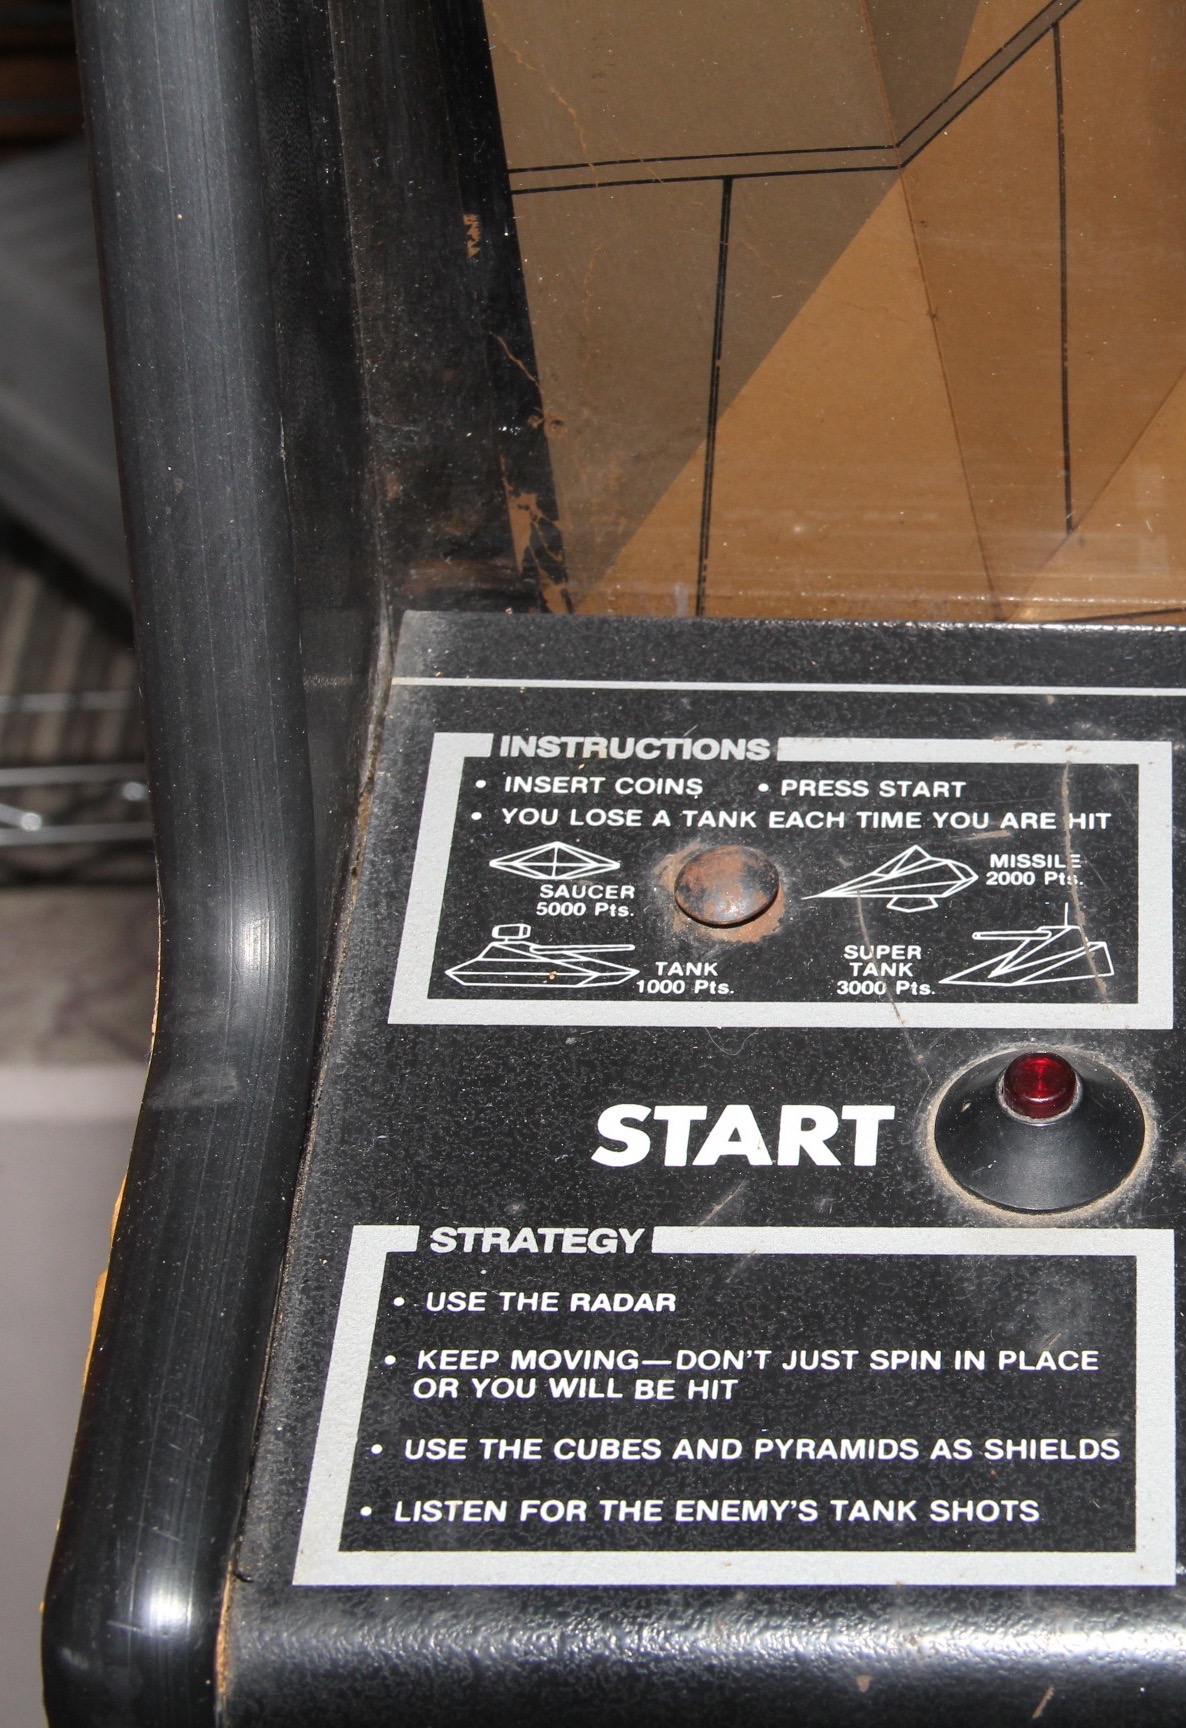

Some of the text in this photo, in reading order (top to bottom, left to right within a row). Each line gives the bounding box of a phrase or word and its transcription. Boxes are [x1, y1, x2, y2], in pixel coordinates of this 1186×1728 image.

[499, 735, 771, 761] INSTRUCTIONS
[504, 775, 704, 797] INSERT COINS
[780, 778, 967, 798] PRESS START
[501, 807, 1112, 830] YOU LOSE A TANK EACH TIME YOU ARE HIT
[989, 852, 1082, 870] MISSILE
[985, 870, 1085, 887] 2000 Pts.
[539, 883, 636, 900] SAUCER
[535, 901, 635, 918] 5000 Pts.
[843, 944, 922, 961] SUPER
[654, 961, 719, 977] TANK
[849, 961, 914, 978] TANK
[636, 979, 735, 995] 1000 Pts.
[836, 979, 936, 996] 3000 Pts.
[590, 1103, 896, 1167] START
[429, 1226, 646, 1254] STRATEGY
[426, 1291, 677, 1312] USE THE RADAR
[417, 1349, 500, 1371] KEEP
[781, 1349, 860, 1371] JUST
[869, 1349, 942, 1371] SPIN
[954, 1350, 985, 1371] IN
[998, 1350, 1099, 1371] PLACE
[412, 1377, 739, 1400] OR YOU WILL BE HIT
[404, 1438, 1121, 1461] USE THE CUBES AND PYRAMIDS AS SHIELDS
[394, 1499, 1040, 1523] LISTEN FOR THE ENEMY'S TANK SHOTS
